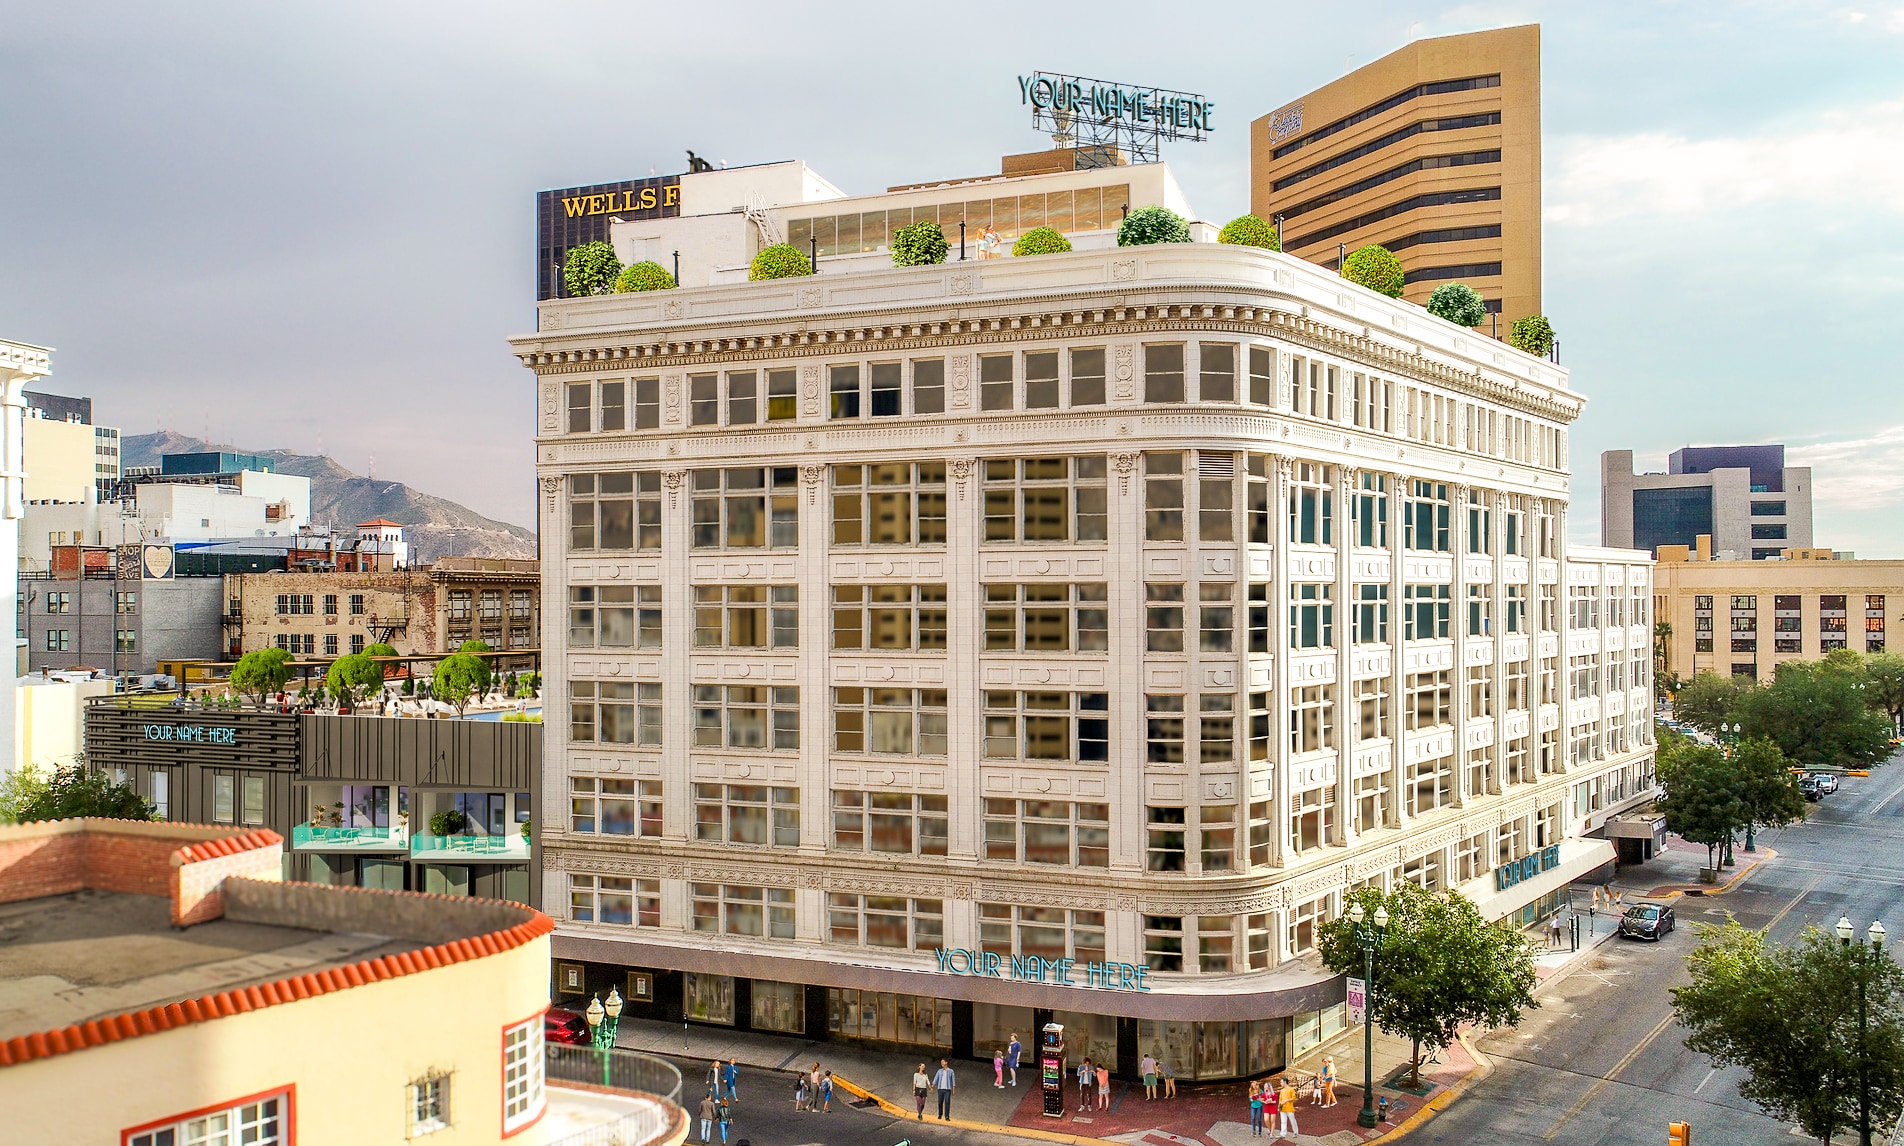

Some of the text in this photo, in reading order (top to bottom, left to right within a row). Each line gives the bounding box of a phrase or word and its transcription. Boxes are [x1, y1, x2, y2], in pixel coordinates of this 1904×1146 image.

[1018, 75, 1216, 131] YOUR NAME HERE
[561, 184, 680, 218] WELLS F
[118, 546, 140, 556] SHOP
[143, 724, 236, 744] YOUR NAME HERE
[935, 947, 1151, 991] YOUR NAME HERE
